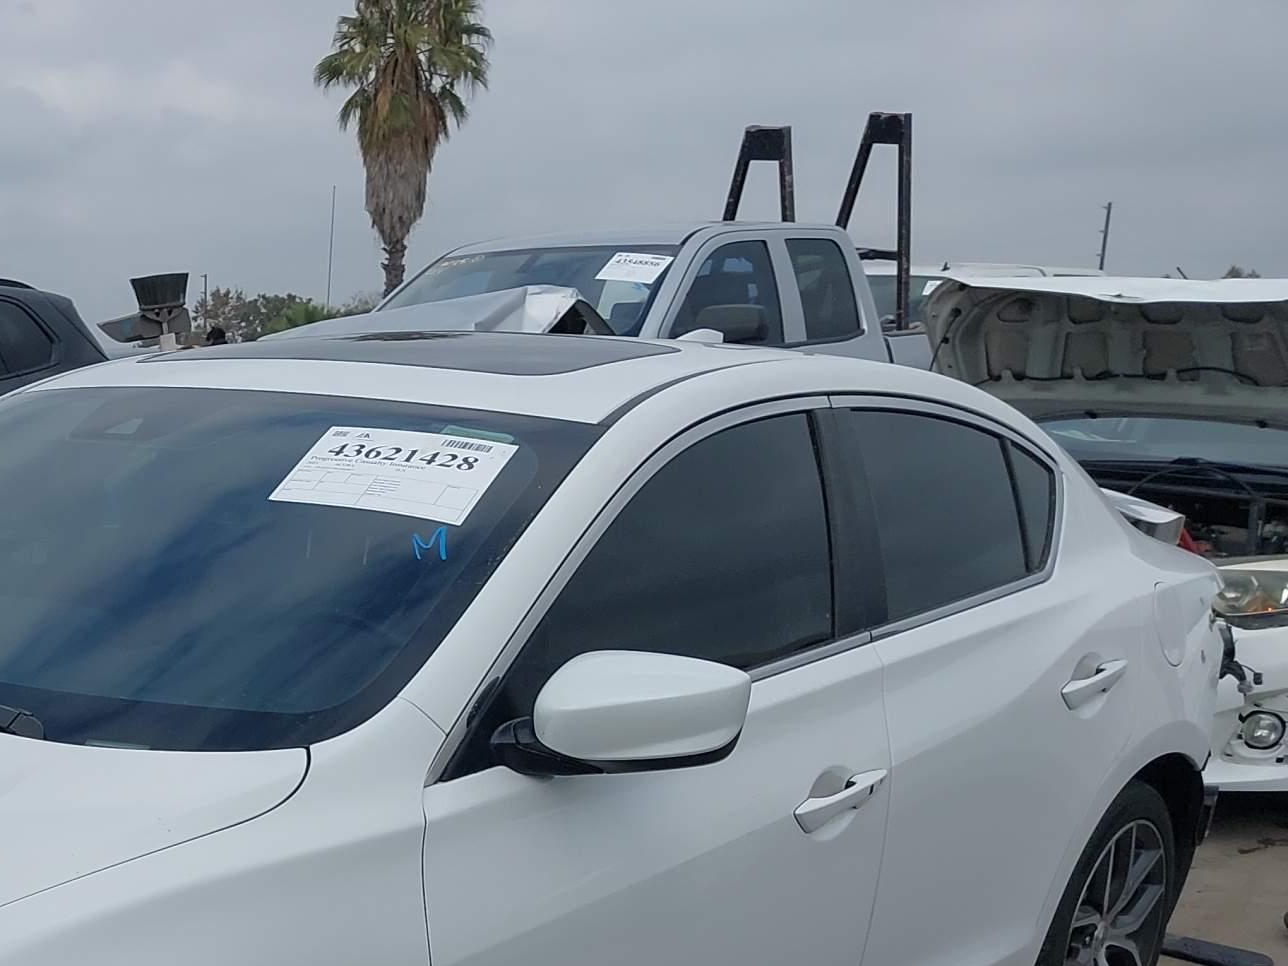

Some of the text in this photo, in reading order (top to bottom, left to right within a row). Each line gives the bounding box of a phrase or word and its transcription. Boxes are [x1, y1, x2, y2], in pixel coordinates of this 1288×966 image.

[310, 455, 355, 464] Progressive
[355, 459, 387, 467] Casualty
[328, 442, 480, 472] 43621428
[412, 526, 448, 561] M
